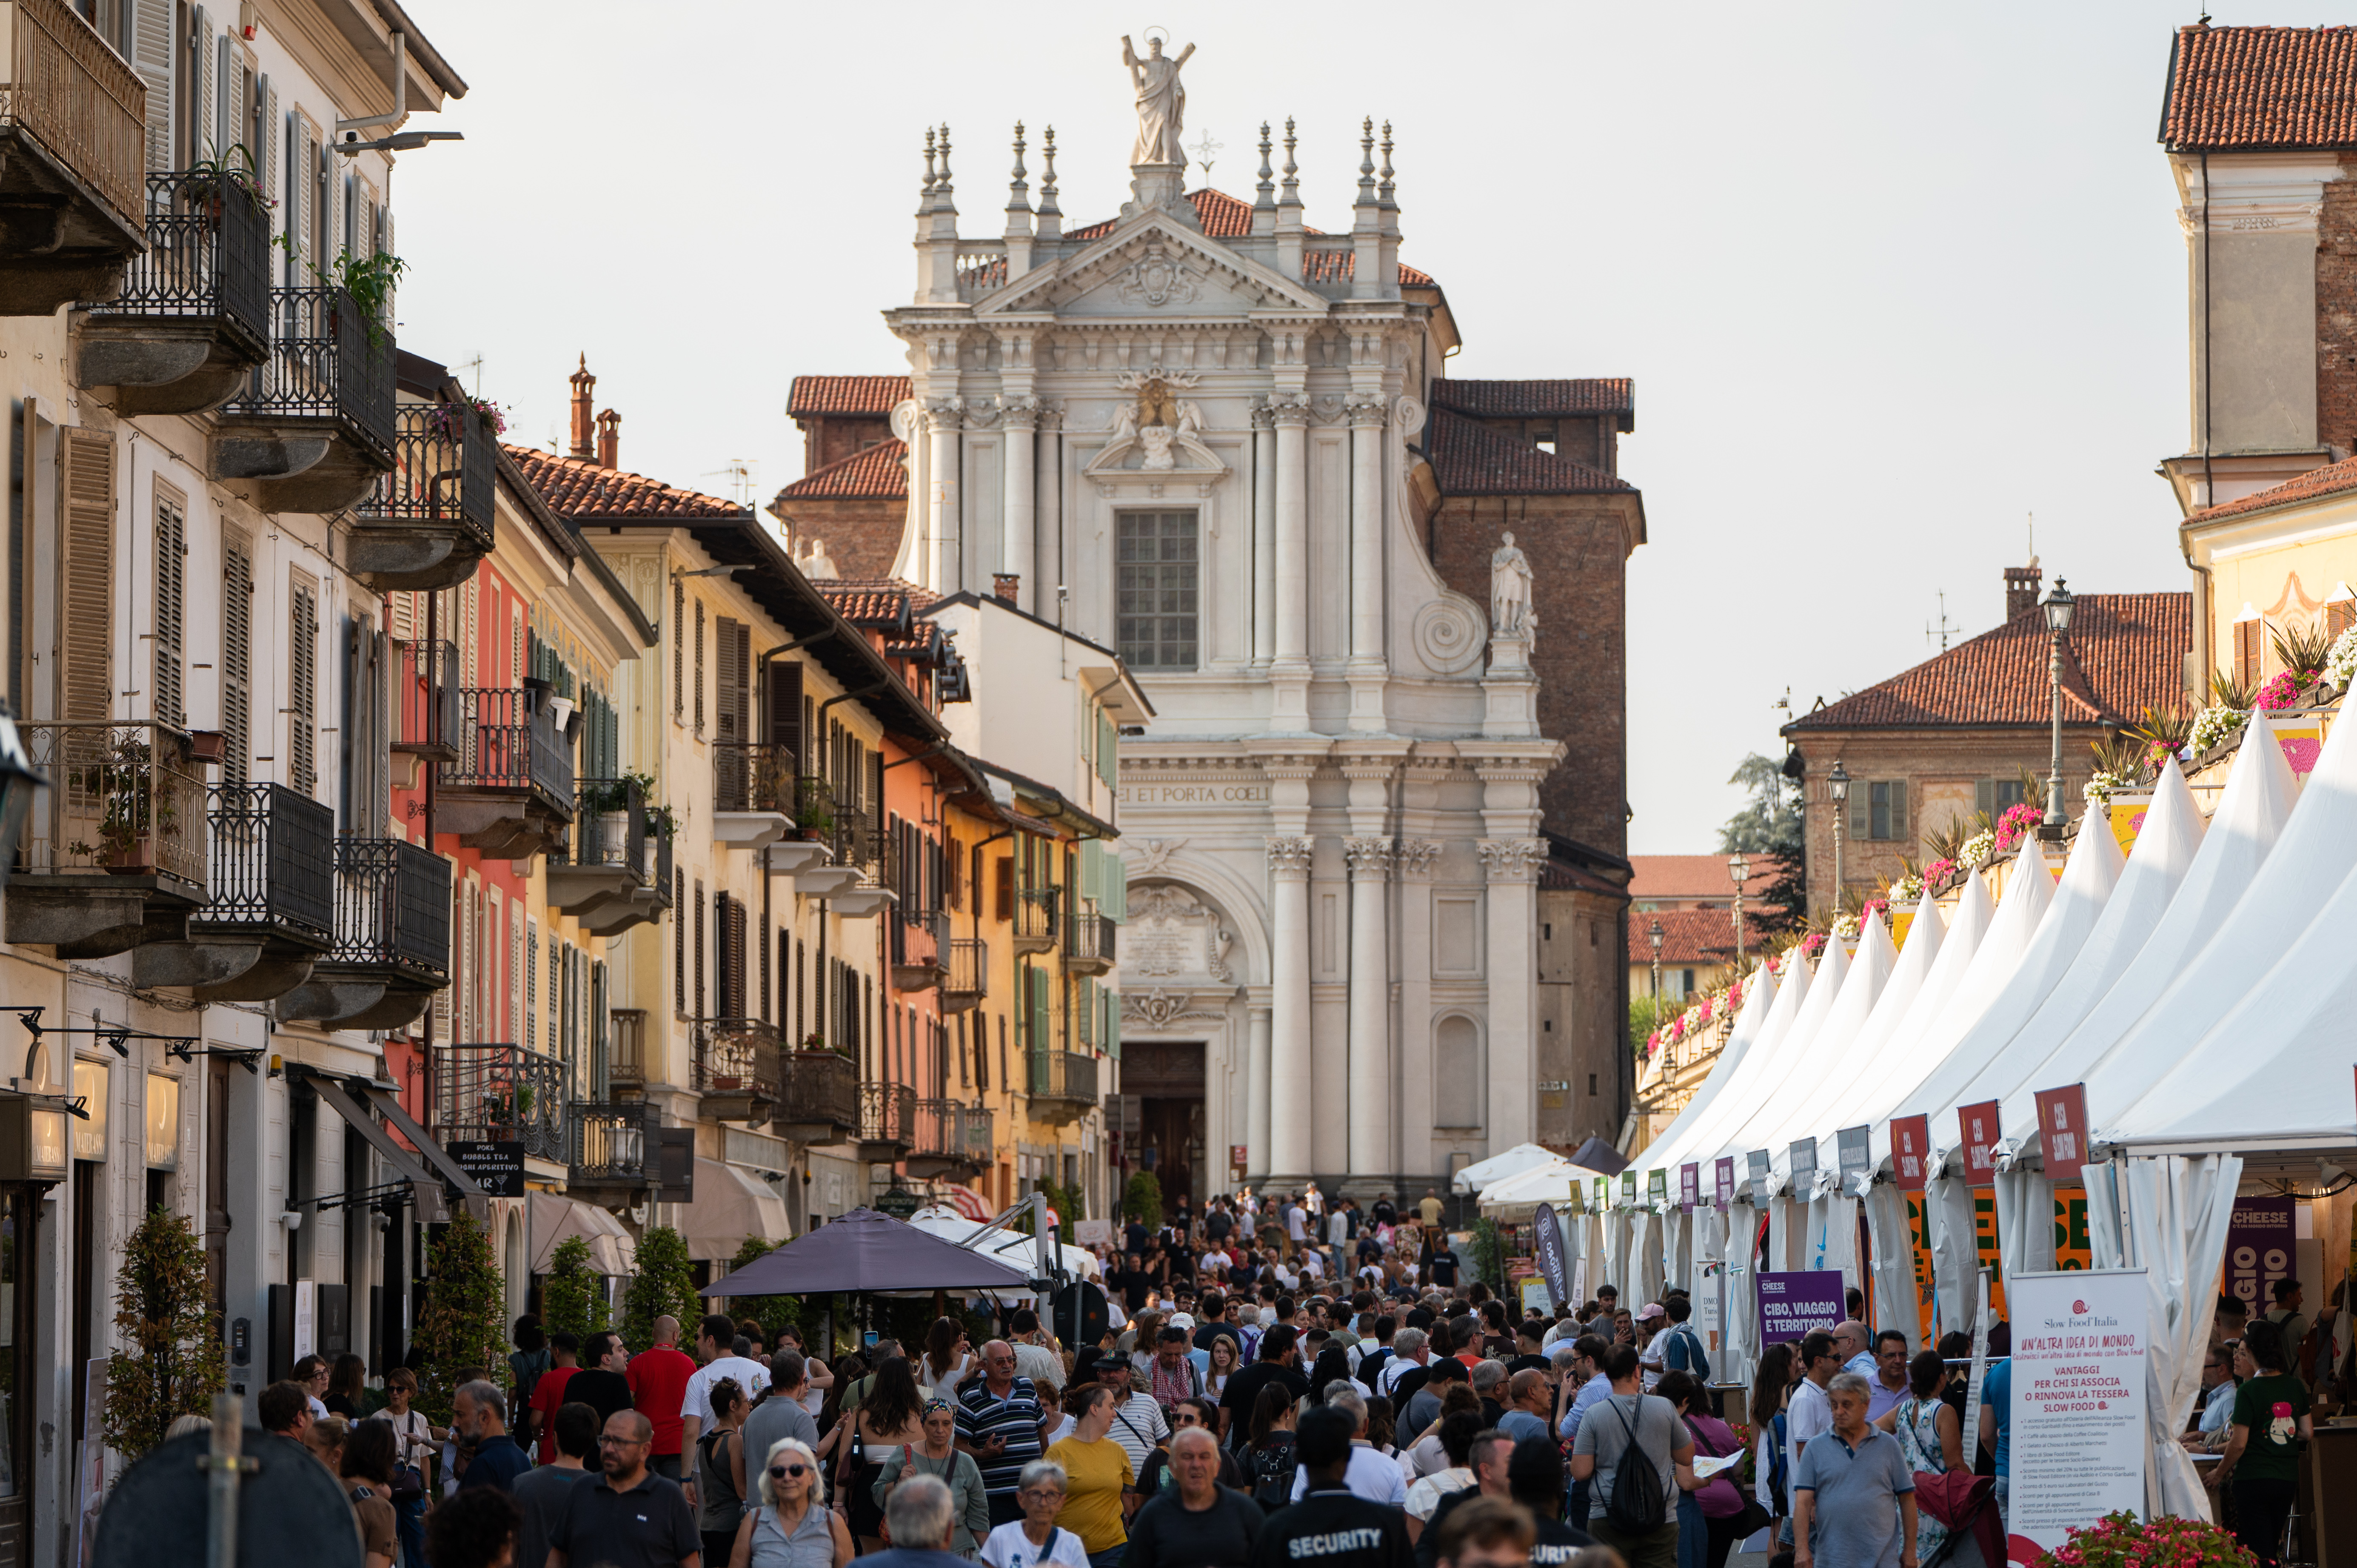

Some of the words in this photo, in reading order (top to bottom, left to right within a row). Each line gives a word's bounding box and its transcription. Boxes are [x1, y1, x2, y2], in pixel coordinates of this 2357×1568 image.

[1138, 788, 1157, 802] ET
[1163, 788, 1216, 802] PORTA
[2054, 1102, 2067, 1130] CASA
[1973, 1118, 1983, 1142] CASA
[1903, 1132, 1912, 1153] CASA
[2052, 1134, 2065, 1161] SLOW
[2063, 1132, 2076, 1160] FOOD
[1971, 1146, 1982, 1169] SLOW
[1980, 1144, 1990, 1168] FOOD
[1902, 1156, 1912, 1177] SLOW
[1910, 1156, 1919, 1177] FOOD
[476, 1178, 492, 1188] AR
[2233, 1212, 2288, 1223] CHEESE
[1762, 1282, 1785, 1290] CHEESE
[1764, 1303, 1792, 1317] CIBO,
[1793, 1301, 1837, 1315] VIAGGIO
[1766, 1320, 1772, 1332] E
[1773, 1318, 1835, 1332] TERRITORIO
[2044, 1318, 2065, 1328] Slow
[2069, 1317, 2090, 1327] Food
[2094, 1316, 2117, 1326] Italia
[2022, 1337, 2063, 1350] UN'ALTRA
[2066, 1336, 2085, 1348] IDEA
[2089, 1336, 2098, 1348] DI
[2102, 1334, 2134, 1347] MONDO
[2013, 1352, 2039, 1360] Costruisci
[2041, 1350, 2062, 1359] un'altra
[2055, 1366, 2100, 1375] VANTAGGI
[2053, 1379, 2068, 1387] CHI
[2071, 1379, 2078, 1387] SI
[2080, 1377, 2120, 1386] ASSOCIA
[2035, 1391, 2075, 1400] RINNOVA
[2091, 1389, 2129, 1398] TESSERA
[2043, 1404, 2069, 1412] SLOW
[2071, 1403, 2095, 1411] FOOD
[1289, 1528, 1382, 1559] SECURITY
